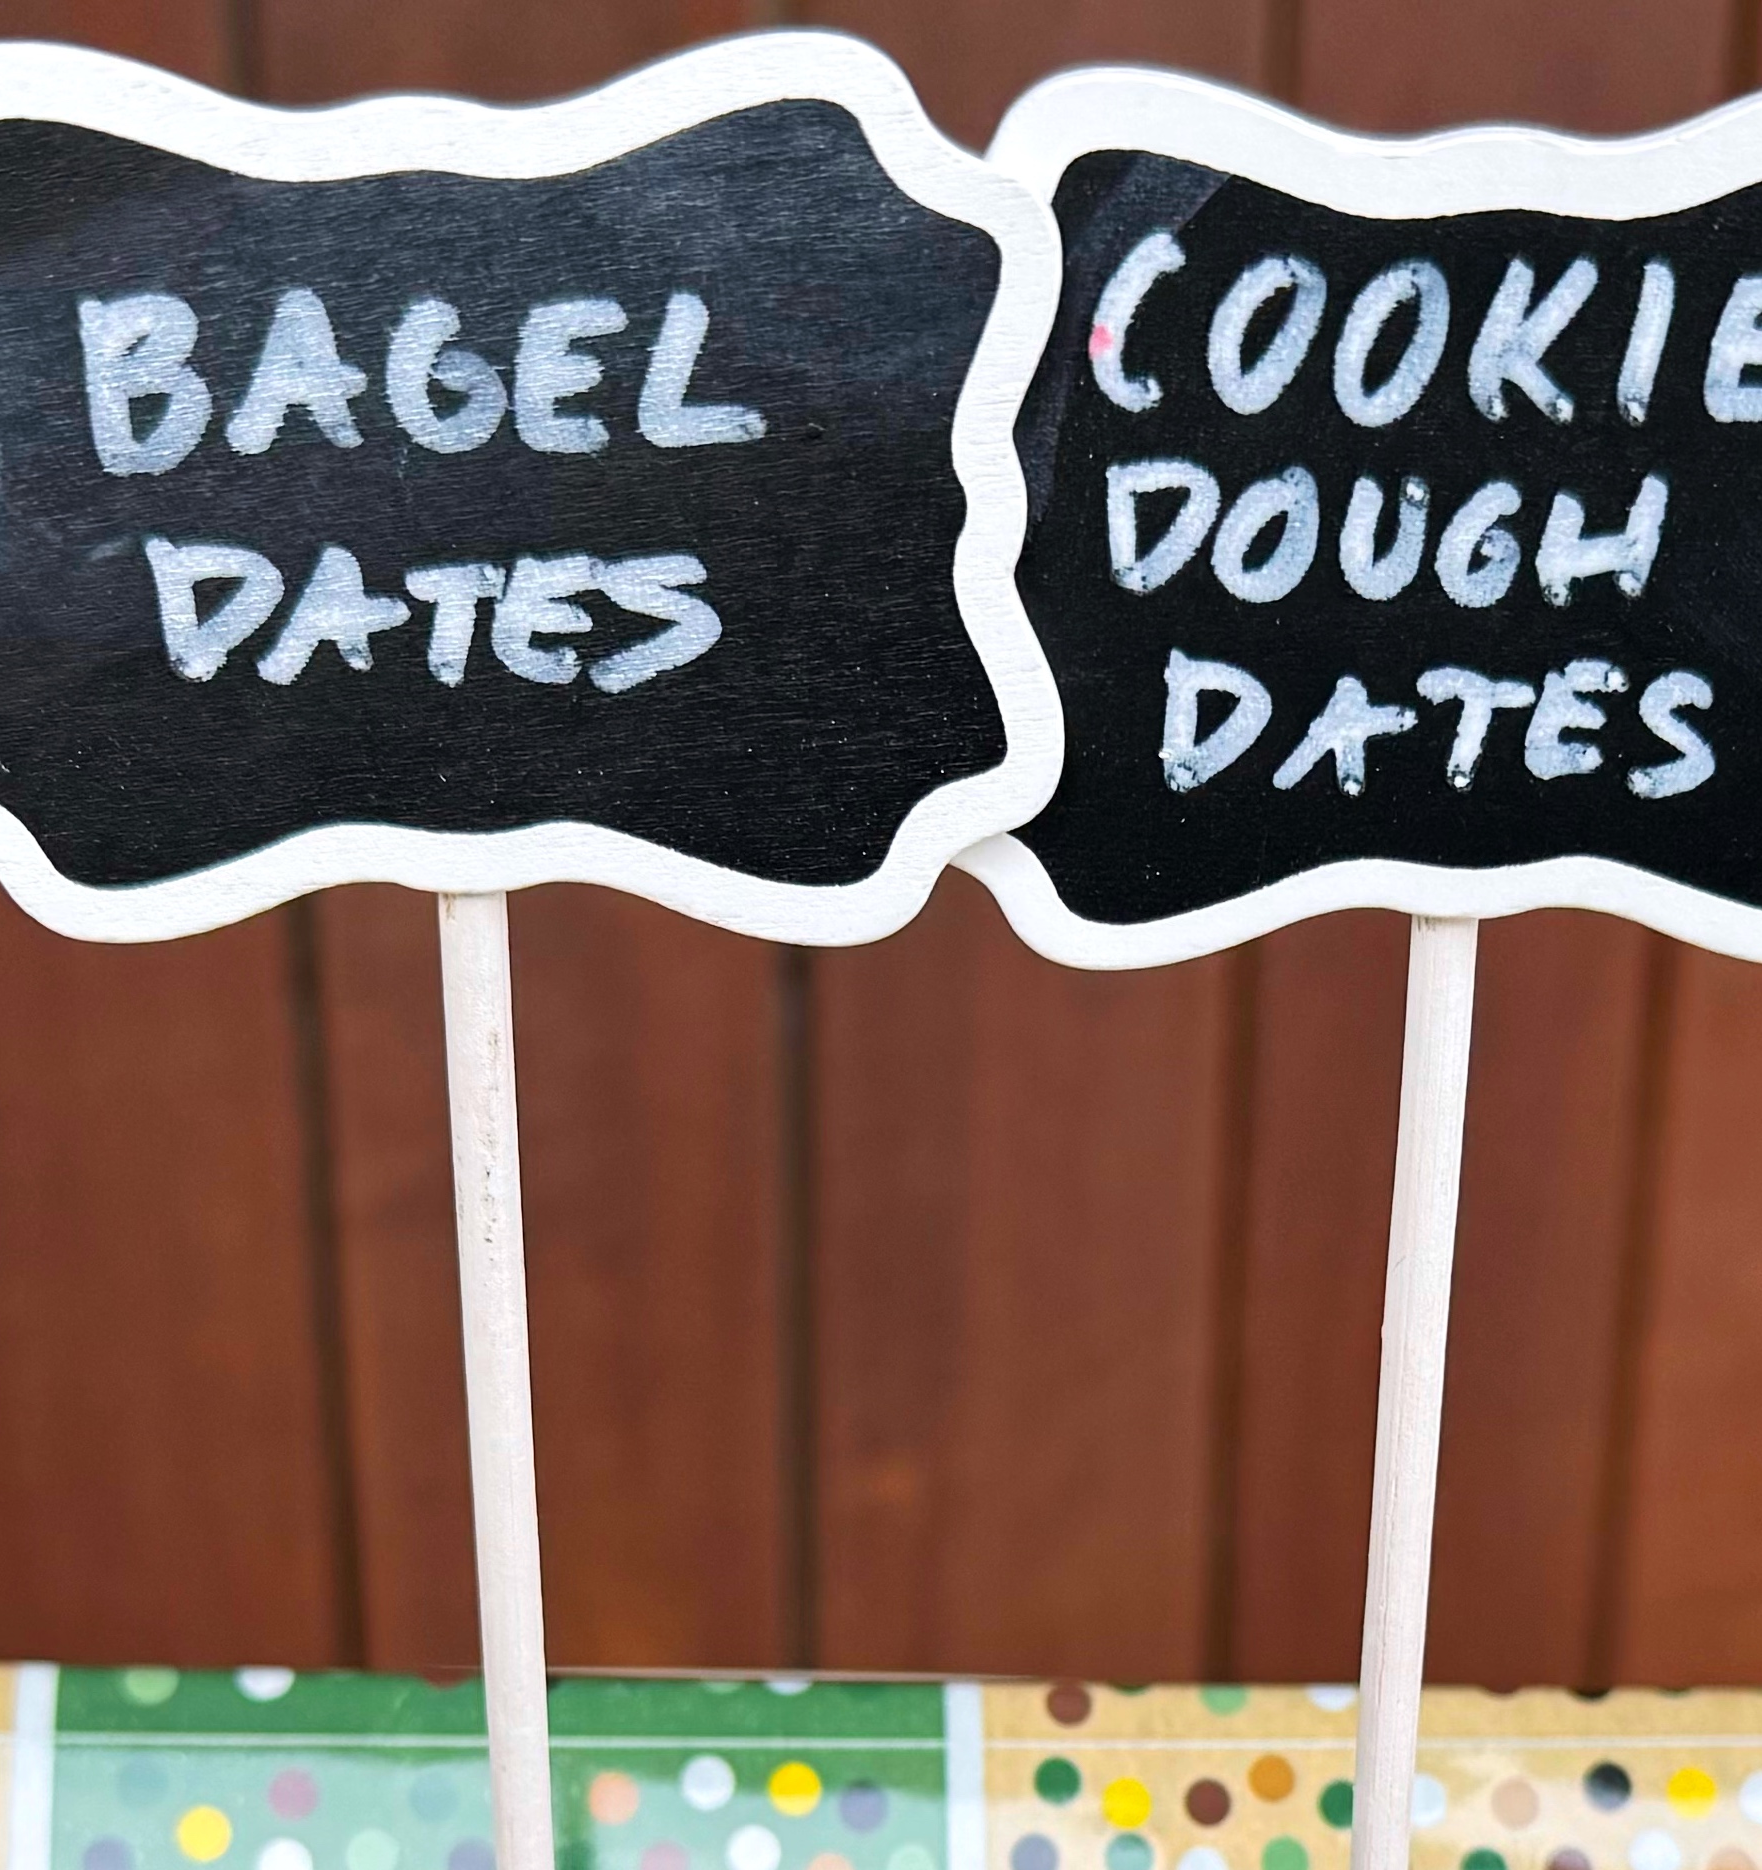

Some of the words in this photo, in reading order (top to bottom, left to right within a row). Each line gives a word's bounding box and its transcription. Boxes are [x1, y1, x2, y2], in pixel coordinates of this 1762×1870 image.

[79, 289, 765, 476] BAGEL
[1106, 462, 1667, 607] DOUGH
[146, 539, 722, 693] DATES
[1159, 650, 1714, 798] DATES
